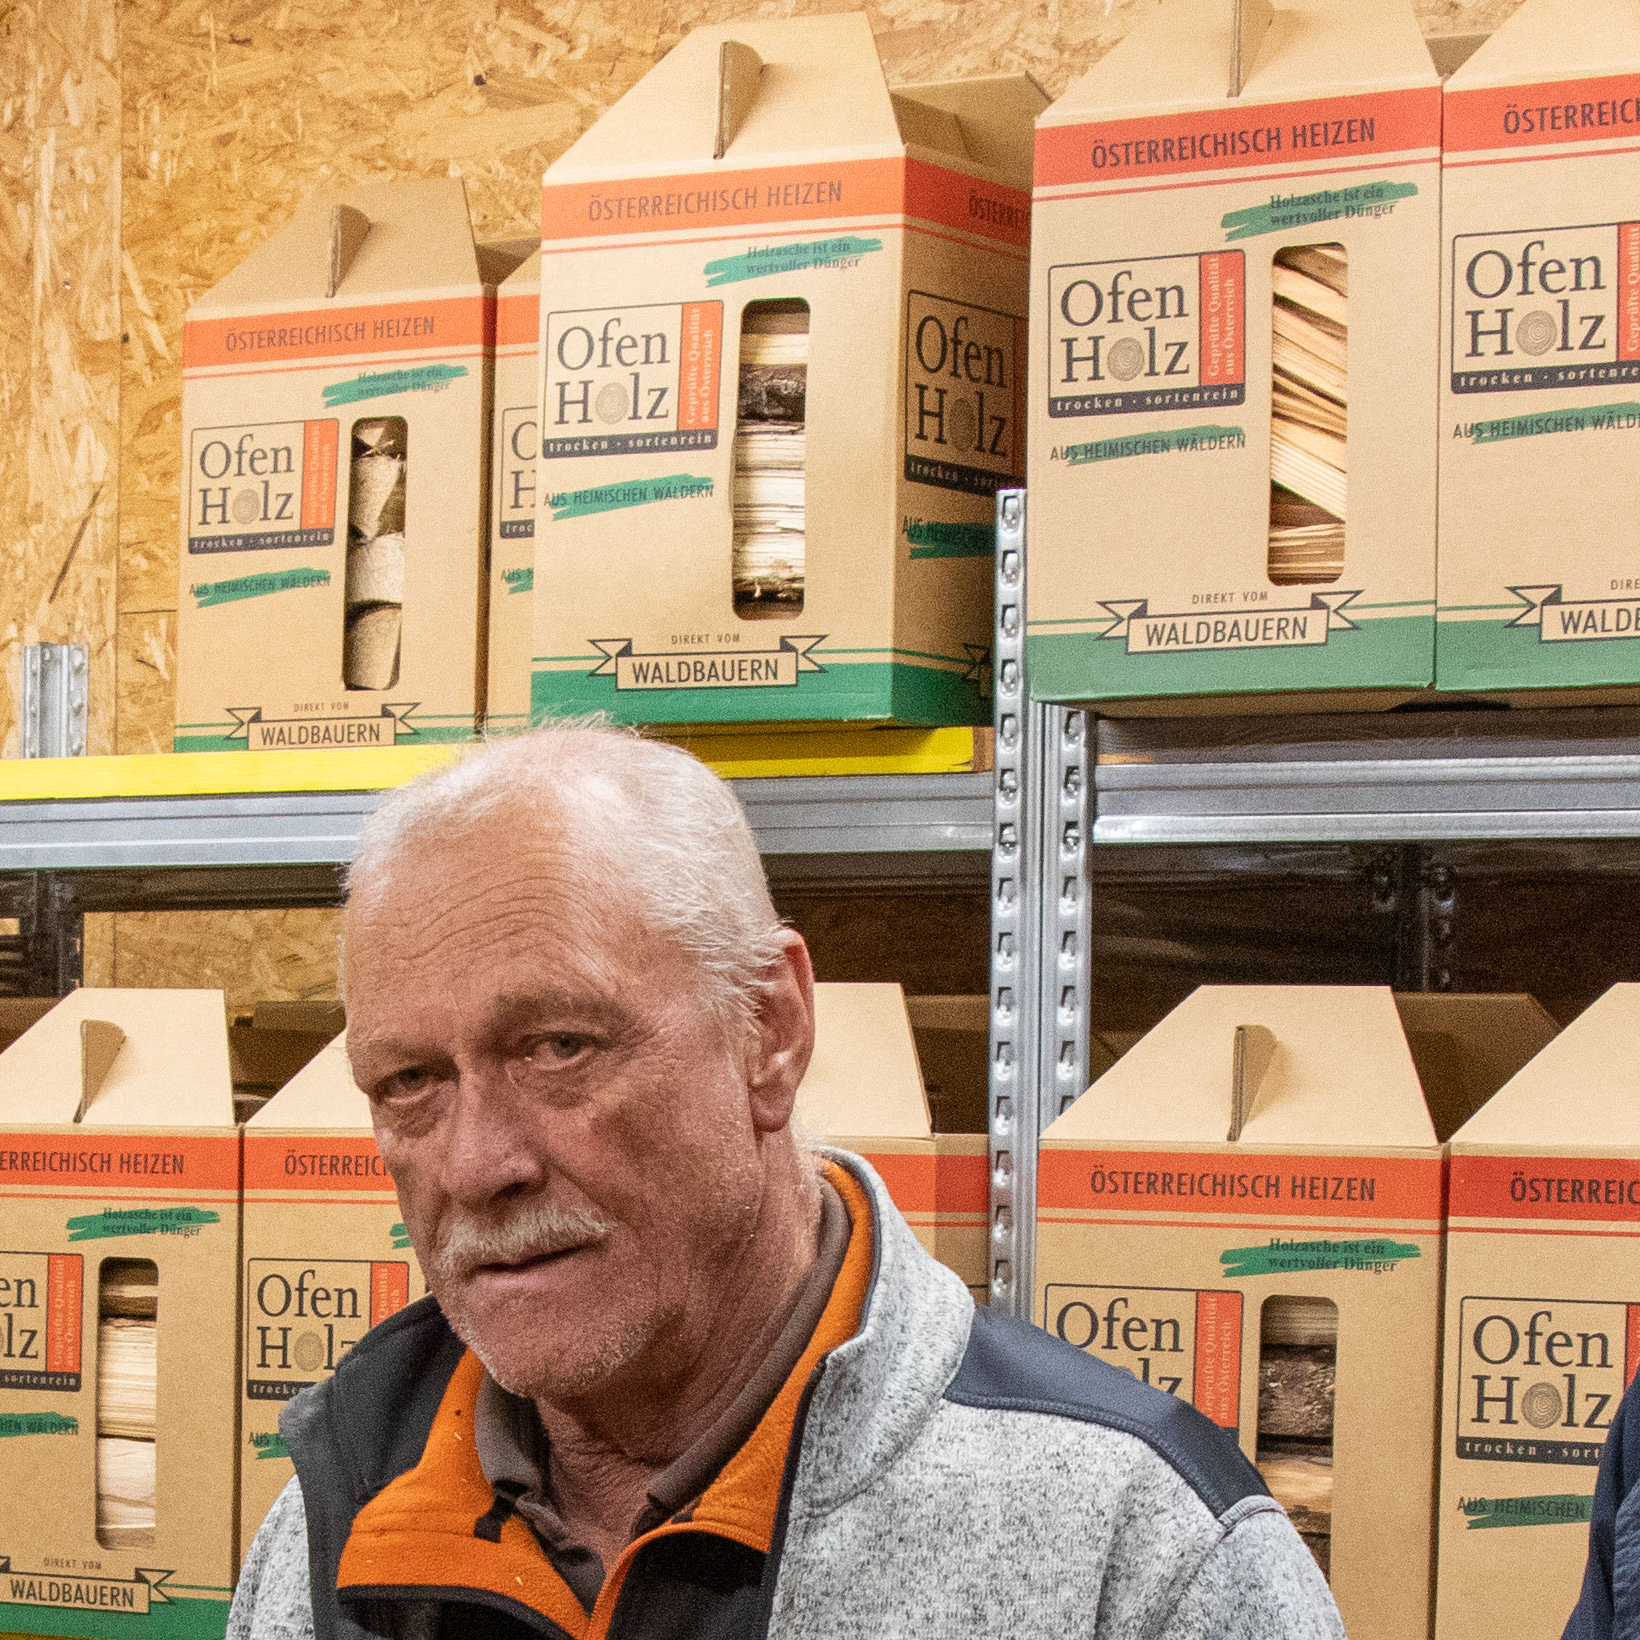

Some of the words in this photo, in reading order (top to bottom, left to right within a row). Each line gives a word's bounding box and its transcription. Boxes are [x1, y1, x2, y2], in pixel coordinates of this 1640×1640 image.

[1091, 126, 1283, 169] ÖSTERREICHISCH
[1291, 117, 1377, 148] HEIZEN
[588, 187, 758, 222] ÖSTERREICHISCH
[767, 179, 843, 208] HEIZEN
[1269, 192, 1339, 210] Holzasche
[1341, 188, 1360, 203] ist
[1363, 186, 1384, 201] ein
[1269, 207, 1342, 227] wertvoller
[1344, 200, 1396, 223] Dünger
[1465, 240, 1606, 299] Ofen
[1627, 224, 1640, 285] Qualität
[1060, 270, 1190, 327] Ofen
[1209, 255, 1221, 312] Qualität
[1223, 277, 1235, 352] Österreich
[1464, 299, 1606, 358] Holz
[1625, 287, 1639, 353] Geprüfte
[226, 320, 366, 352] ÖSTERREICHISCH
[372, 315, 435, 339] HEIZEN
[556, 317, 671, 371] Ofen
[1208, 315, 1220, 379] Geprüfte
[915, 314, 1007, 388] Ofen
[1059, 327, 1191, 383] Holz
[1223, 353, 1235, 376] aus
[1459, 370, 1533, 388] trocken
[554, 372, 670, 426] Holz
[1056, 395, 1124, 413] trocken
[1145, 388, 1240, 407] sortenrein
[914, 383, 1006, 458] Holz
[1452, 421, 1484, 439] AUS
[1489, 414, 1586, 436] HEIMISCHEN
[199, 433, 295, 479] Ofen
[547, 438, 609, 453] trocken
[627, 432, 712, 449] sortenrein
[1049, 444, 1078, 461] AUS
[1084, 437, 1172, 458] HEIMISCHEN
[1176, 431, 1247, 453] WÄLDERN
[198, 480, 295, 526] Holz
[543, 493, 568, 508] AUS
[573, 486, 648, 506] HEIMISCHEN
[653, 480, 715, 500] WÄLDERN
[1191, 591, 1236, 606] DIREKT
[1241, 590, 1269, 604] VOM
[671, 634, 710, 646] DIREKT
[717, 633, 741, 644] VOM
[1145, 616, 1308, 648] WALDBAUERN
[631, 658, 779, 684] WALDBAUERN
[293, 703, 325, 713] DIREKT
[330, 702, 350, 711] VOM
[260, 723, 381, 746] WALDBAUERN
[119, 1153, 185, 1175] HEIZEN
[1090, 1165, 1281, 1200] ÖSTERREICHISCH
[1291, 1175, 1376, 1202] HEIZEN
[1269, 1237, 1340, 1254] Holzasche
[1343, 1239, 1359, 1254] ist
[1363, 1242, 1385, 1256] ein
[1343, 1257, 1398, 1274] Dünger
[257, 1269, 363, 1319] Ofen
[1056, 1297, 1185, 1353] Ofen
[1205, 1296, 1217, 1356] Qualität
[1472, 1310, 1614, 1369] Ofen
[1219, 1320, 1232, 1396] Österreich
[4, 1373, 77, 1387] sortenrein
[1219, 1396, 1230, 1420] aus
[1464, 1440, 1537, 1457] trocken
[1456, 1496, 1487, 1513] AUS
[1493, 1499, 1585, 1520] HEIMISCHEN
[43, 1556, 77, 1570] DIREKT
[82, 1559, 102, 1570] VOM
[10, 1579, 135, 1608] WALDBAUERN
